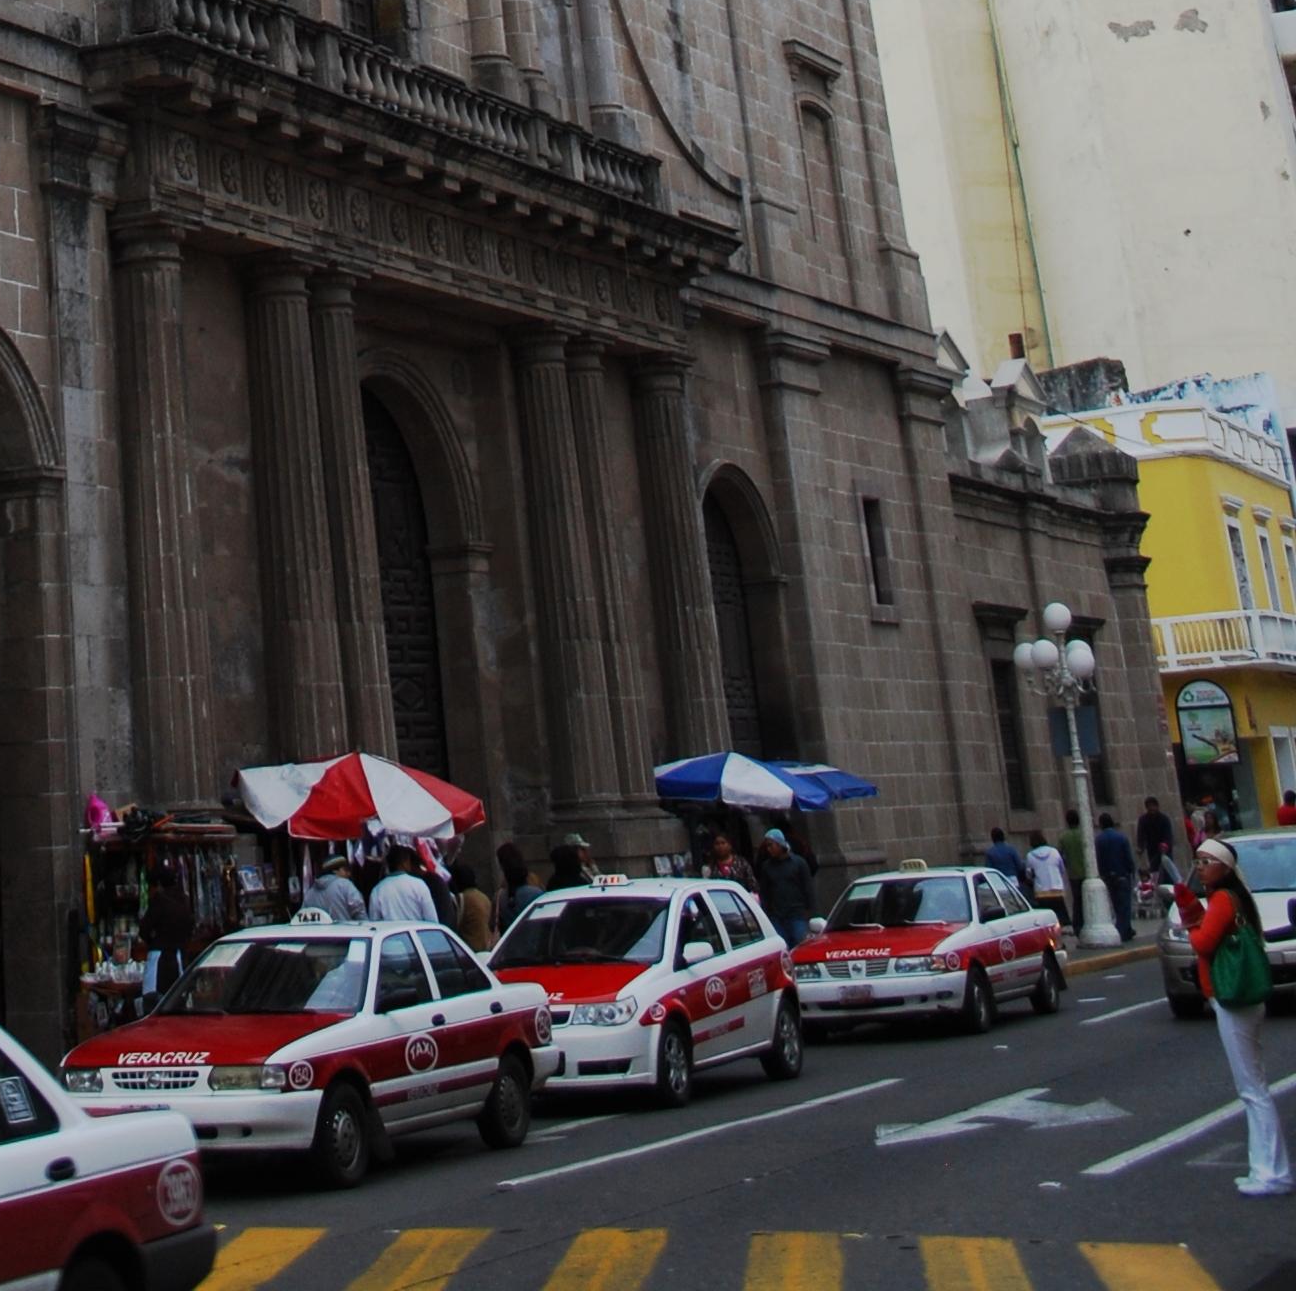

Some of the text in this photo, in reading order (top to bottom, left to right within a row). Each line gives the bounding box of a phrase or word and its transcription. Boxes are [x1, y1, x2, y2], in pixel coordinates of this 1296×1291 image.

[297, 912, 321, 923] TAXI
[825, 947, 891, 960] VERACRUZ
[409, 1040, 434, 1060] TAXI
[117, 1051, 210, 1066] VERACRUZ
